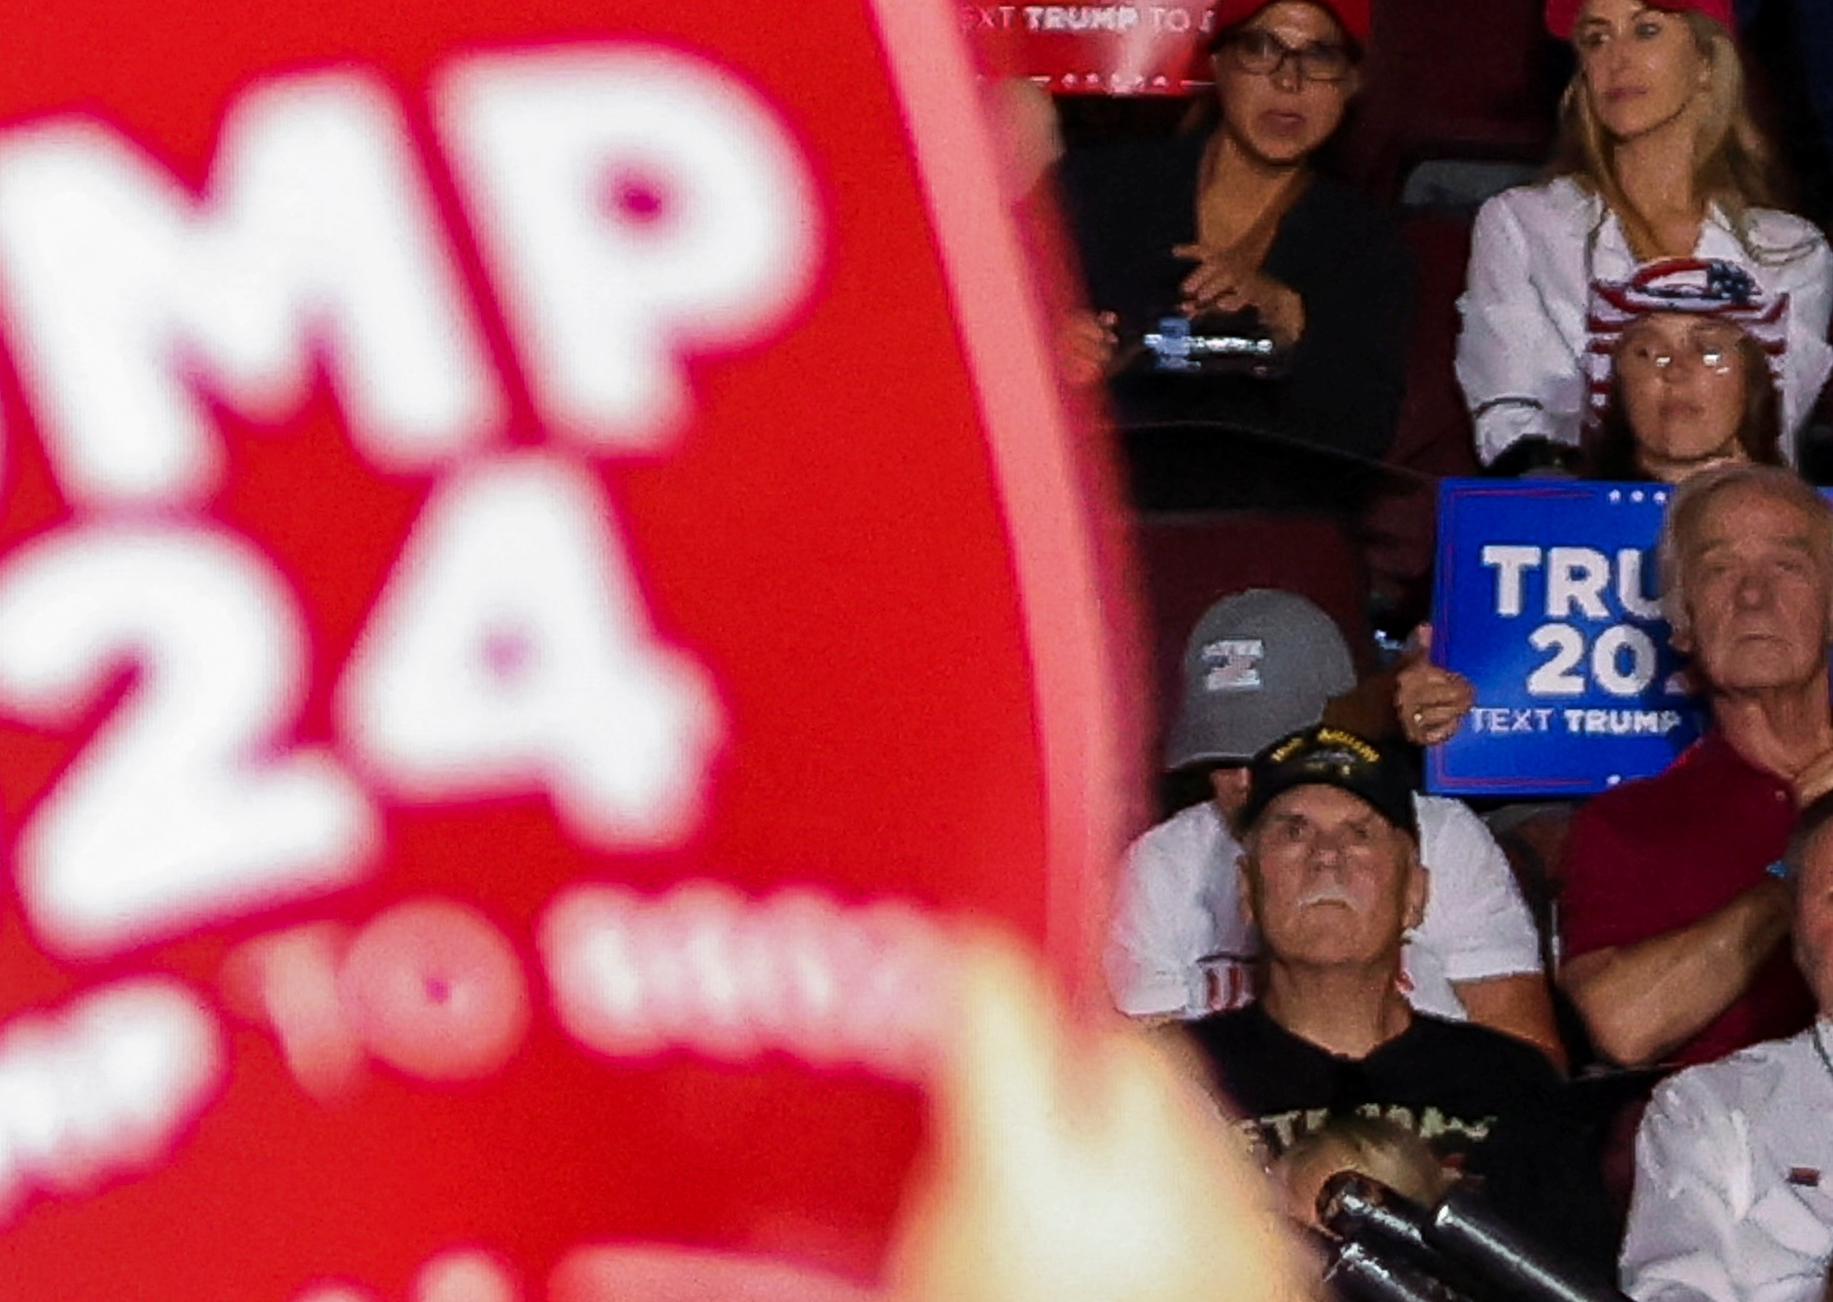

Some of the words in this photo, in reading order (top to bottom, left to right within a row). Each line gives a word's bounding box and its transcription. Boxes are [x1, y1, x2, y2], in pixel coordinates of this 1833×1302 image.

[1023, 5, 1139, 32] TRUMP
[1147, 6, 1192, 33] TO
[1481, 544, 1662, 620] TRU
[1526, 622, 1685, 697] 20
[1470, 706, 1555, 733] TEXT
[1563, 708, 1681, 735] TRUMP
[221, 898, 525, 1098] TO
